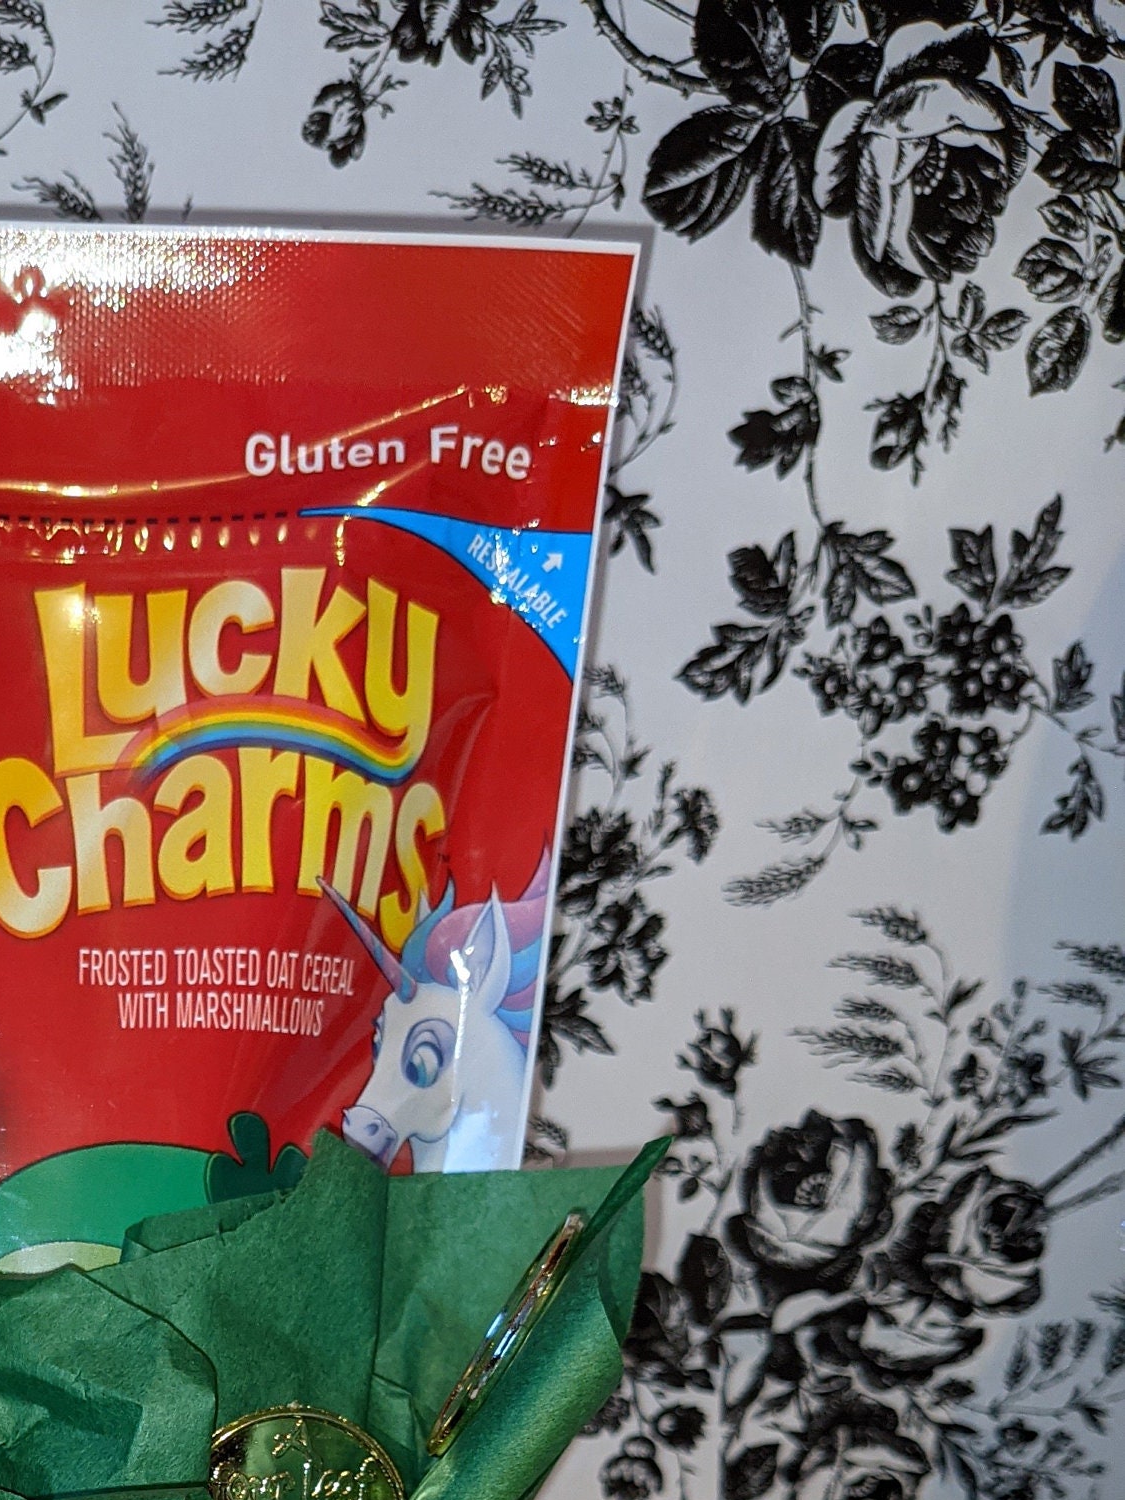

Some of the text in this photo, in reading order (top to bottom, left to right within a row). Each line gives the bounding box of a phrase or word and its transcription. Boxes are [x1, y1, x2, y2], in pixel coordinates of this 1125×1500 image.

[245, 425, 531, 480] Gluten Free
[34, 566, 440, 778] Lucky
[78, 947, 355, 996] FROSTED TOASTED OAT CEREAL
[118, 992, 323, 1037] WITH MARSHMALLOWS
